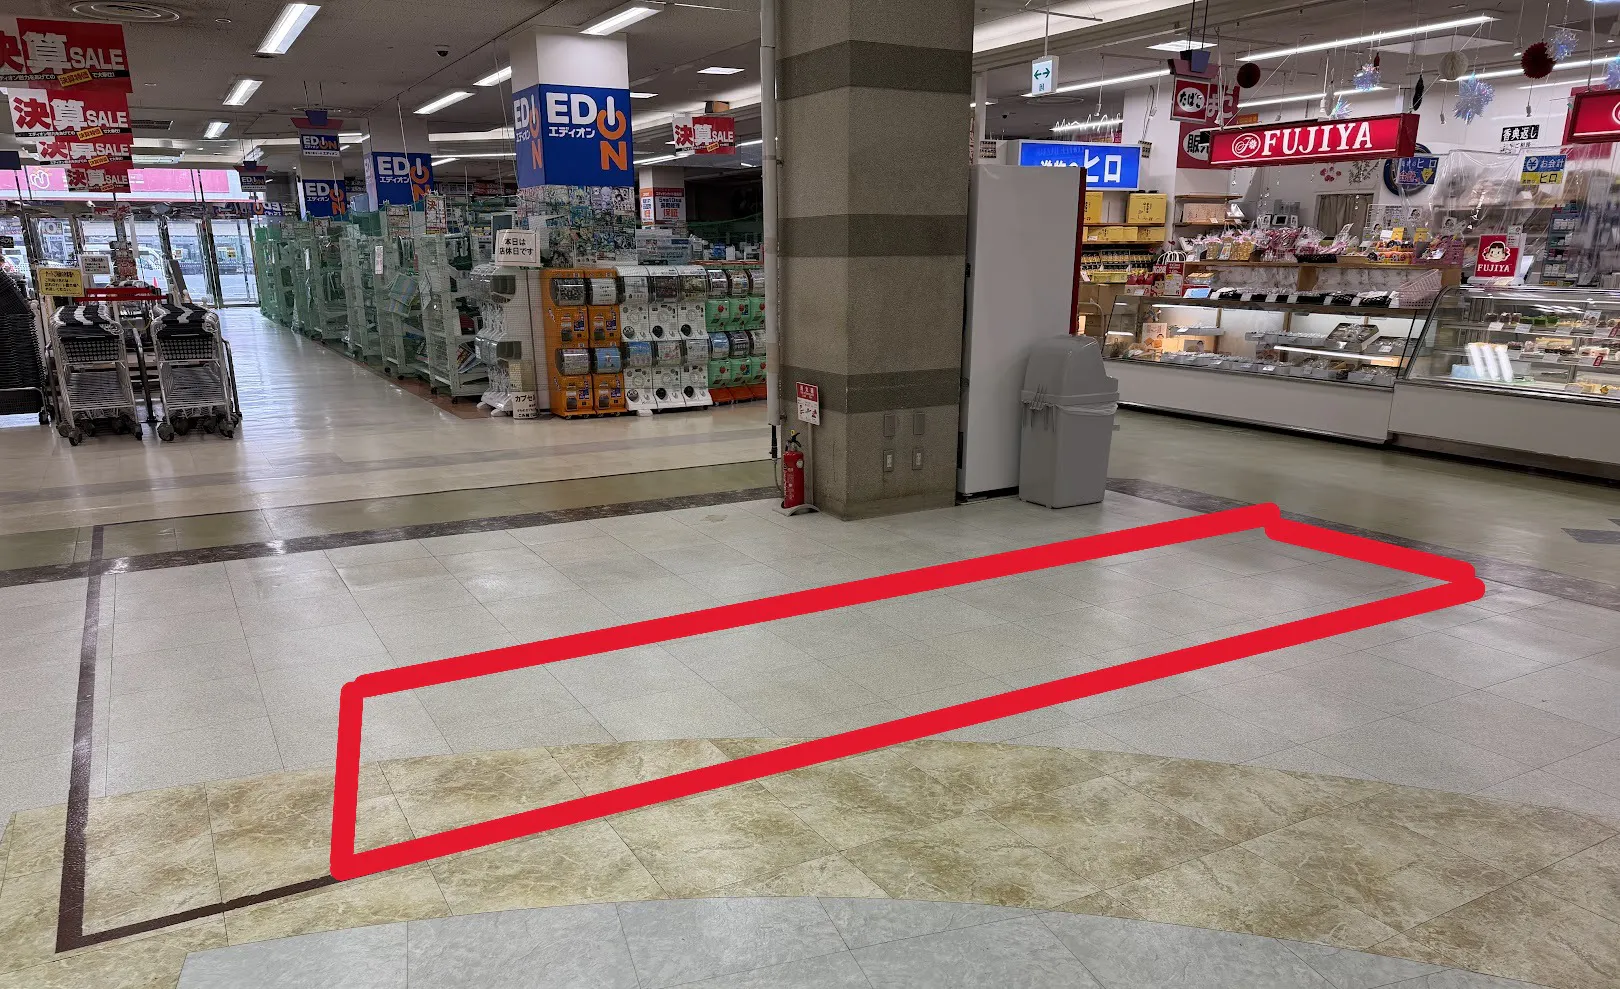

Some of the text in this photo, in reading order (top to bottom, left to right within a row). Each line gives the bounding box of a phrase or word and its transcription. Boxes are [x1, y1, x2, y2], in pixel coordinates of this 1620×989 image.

[1179, 91, 1202, 108] たばこ
[546, 92, 627, 170] EDION
[548, 126, 595, 138] エディオン
[1502, 126, 1537, 142] 香典返し
[1262, 121, 1373, 156] FUJIYA
[1084, 149, 1121, 183] ヒロ
[1540, 159, 1565, 168] お会計
[380, 176, 409, 184] エディオン
[1539, 173, 1558, 184] ヒロ
[504, 238, 526, 246] 本日は
[499, 247, 533, 255] 店休日です
[1476, 263, 1510, 273] FUJIYA
